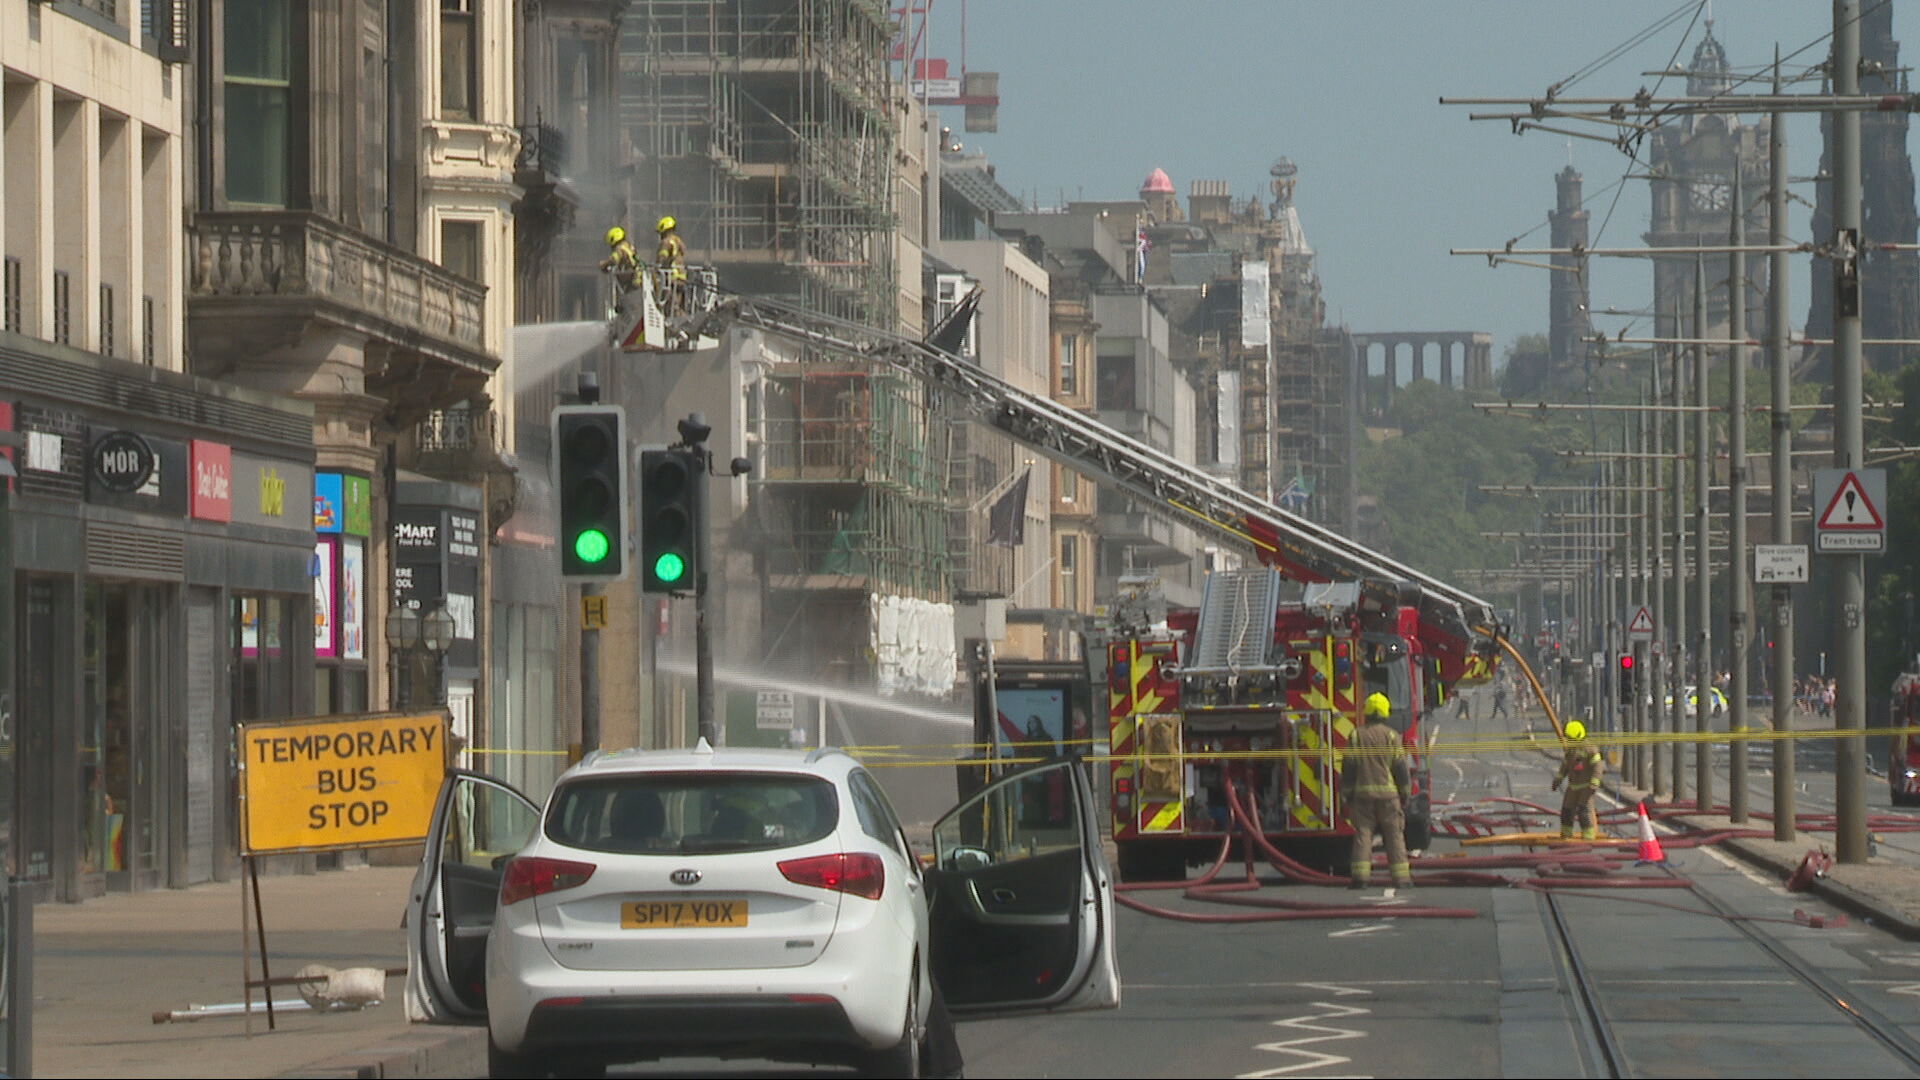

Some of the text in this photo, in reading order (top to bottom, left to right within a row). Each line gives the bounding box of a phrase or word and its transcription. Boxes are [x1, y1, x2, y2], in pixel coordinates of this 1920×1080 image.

[1824, 536, 1878, 545] Tram tracks
[254, 725, 437, 763] TEMPORARY
[318, 766, 377, 794] BUS
[309, 801, 388, 829] STOP
[634, 902, 734, 924] SP17 YOX
